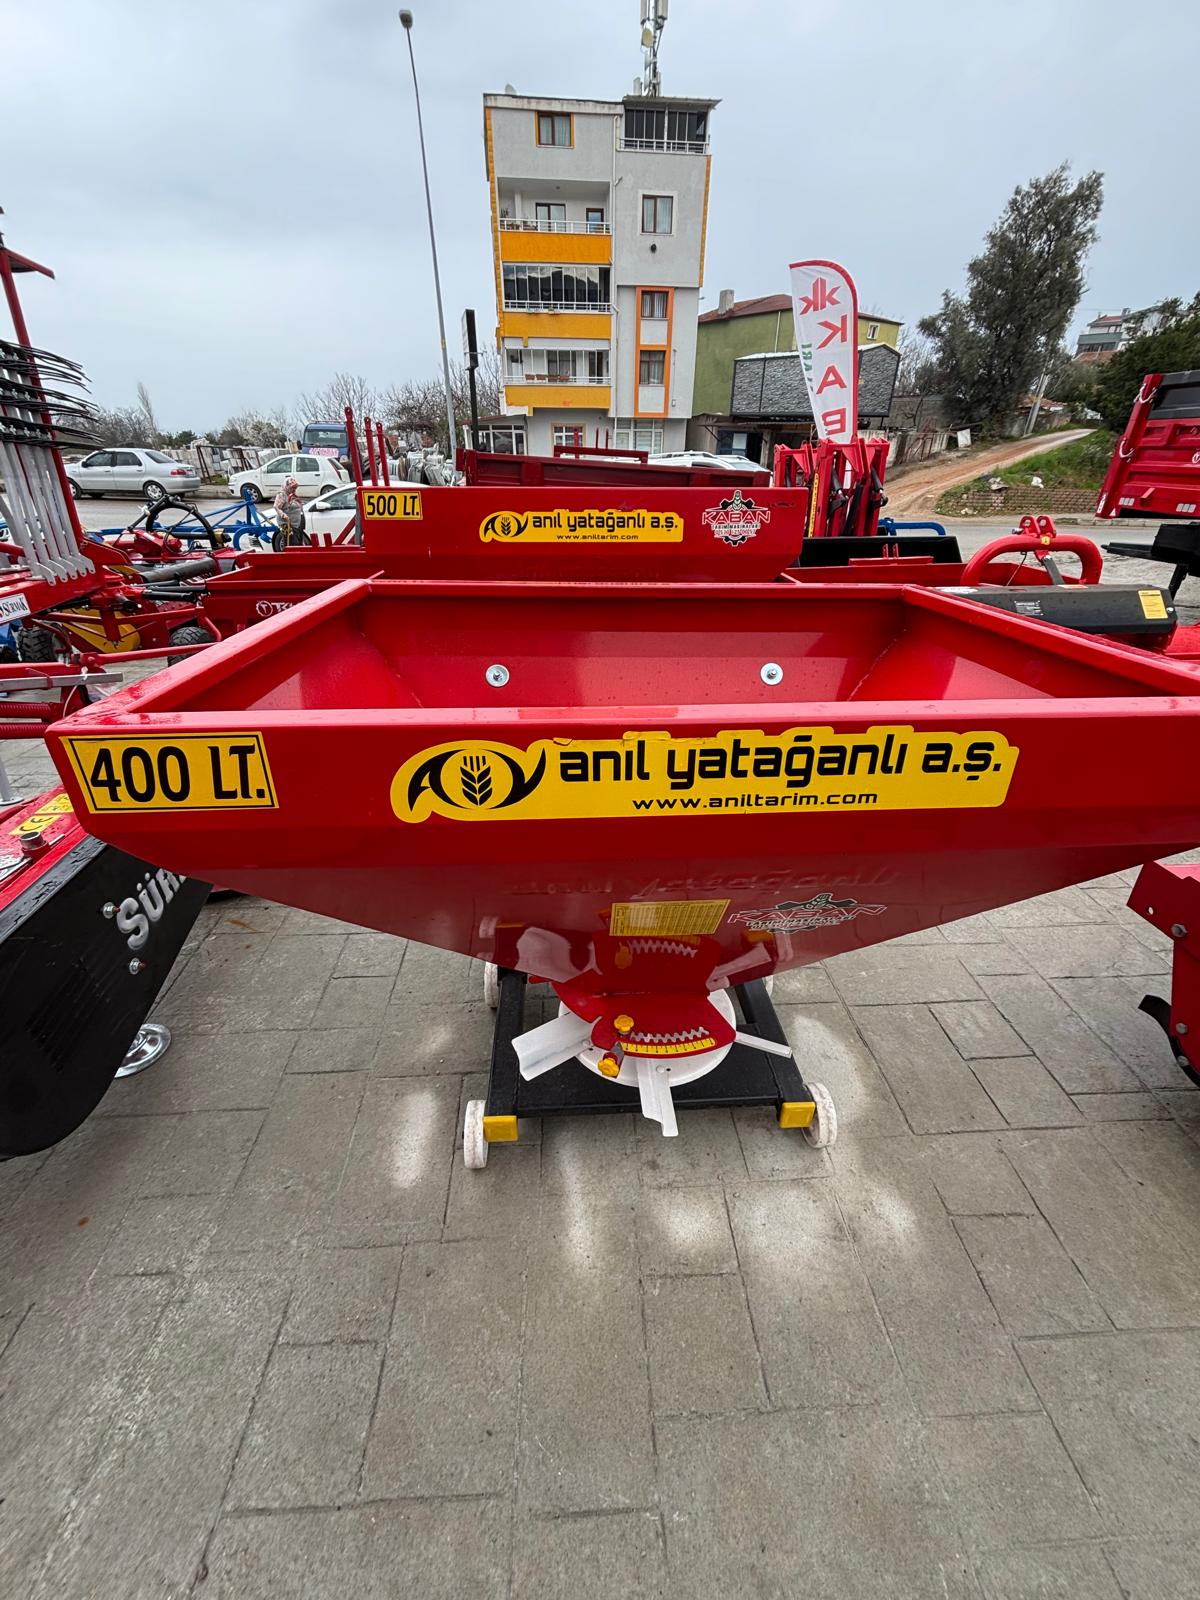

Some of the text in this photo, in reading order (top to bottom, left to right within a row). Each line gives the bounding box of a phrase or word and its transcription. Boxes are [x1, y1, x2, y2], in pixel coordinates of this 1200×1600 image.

[367, 494, 420, 516] 500 LT.
[650, 515, 678, 532] a.ş.
[701, 510, 771, 526] KABAN
[556, 533, 639, 541] www.aniltarim.com
[667, 734, 907, 790] yatağanlı
[921, 741, 1002, 781] a.ş.
[90, 743, 266, 803] 400 LT.
[632, 791, 878, 809] www.aniltarim.com
[727, 904, 888, 924] KABAN
